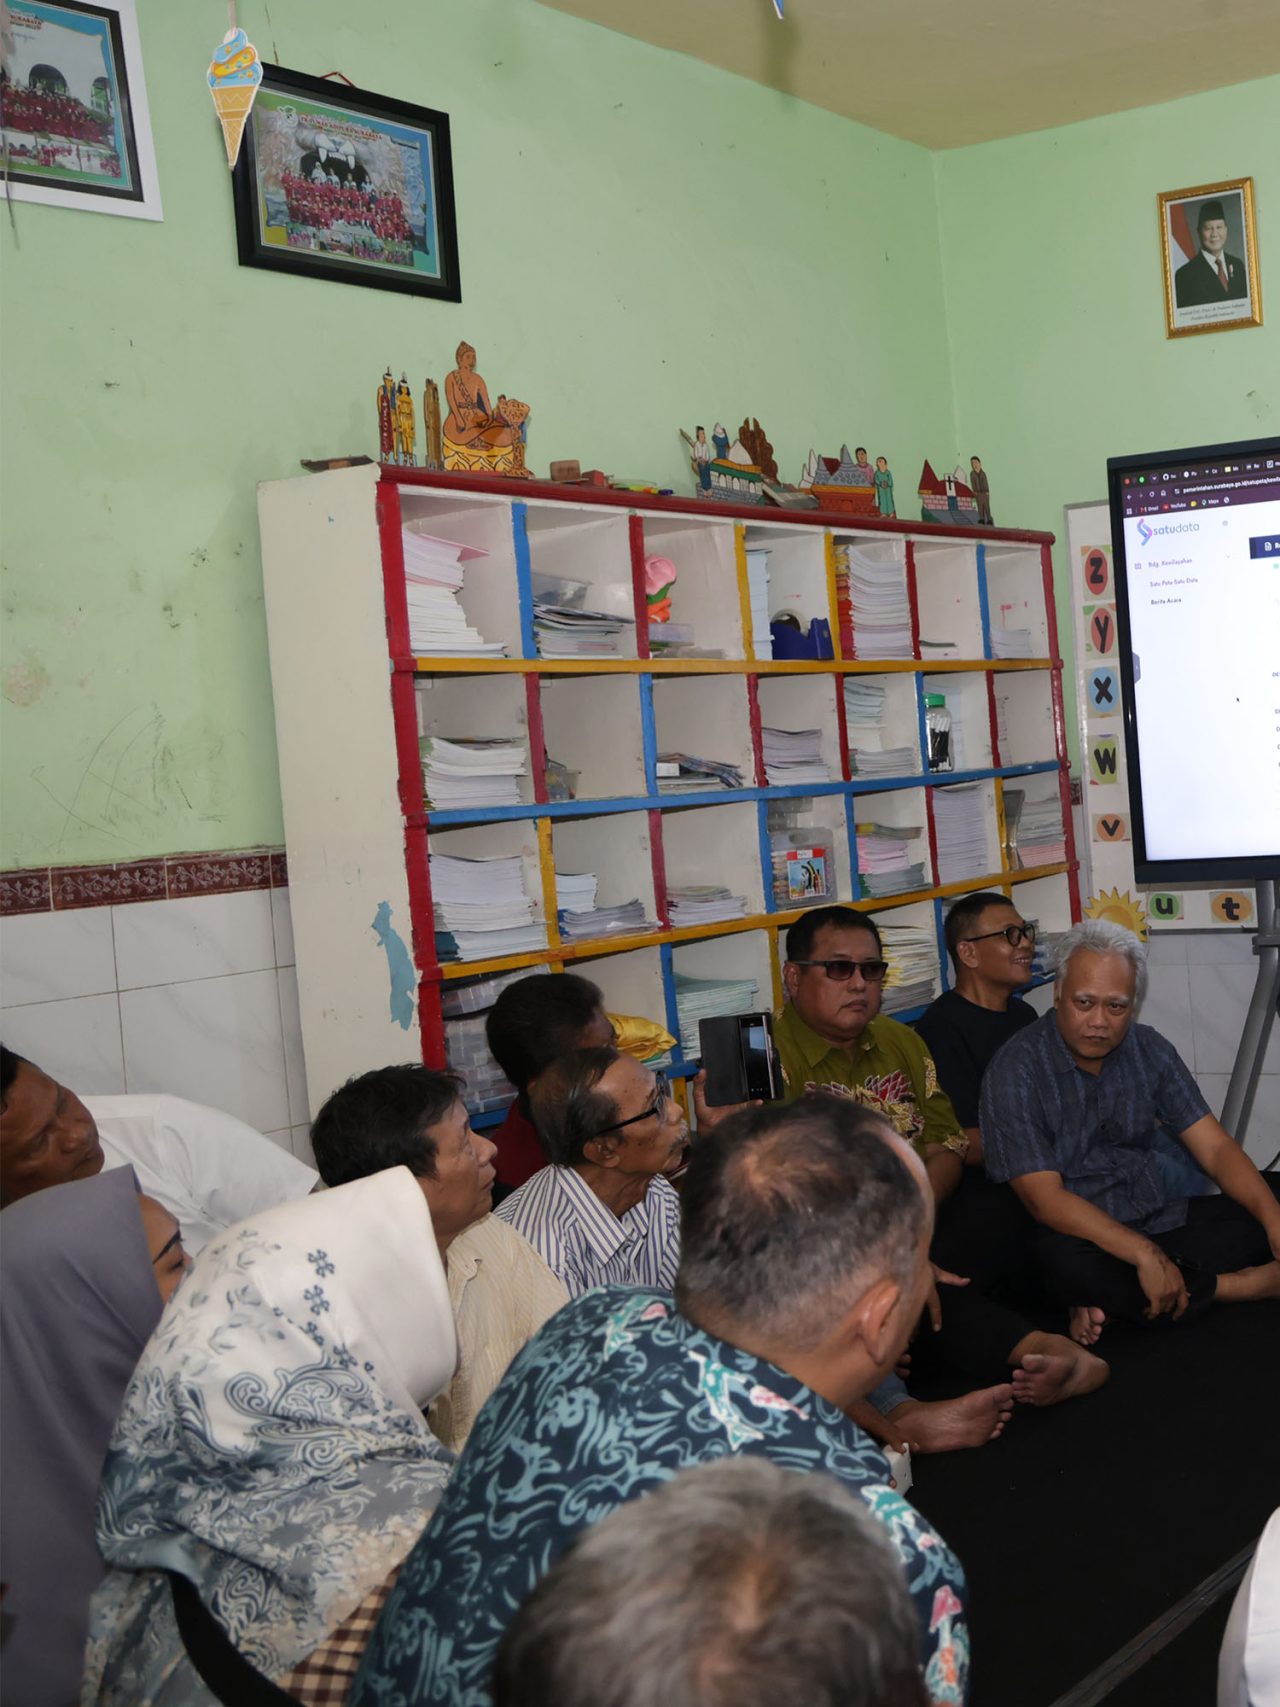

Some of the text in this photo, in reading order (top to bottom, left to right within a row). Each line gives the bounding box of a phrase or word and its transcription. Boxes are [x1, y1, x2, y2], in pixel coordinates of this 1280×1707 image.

[1170, 502, 1187, 510] YouTube
[1153, 522, 1200, 536] satudata
[1095, 614, 1110, 654] y
[1094, 675, 1113, 705] x
[1101, 818, 1121, 838] v
[1155, 897, 1174, 915] u
[1221, 896, 1240, 921] t
